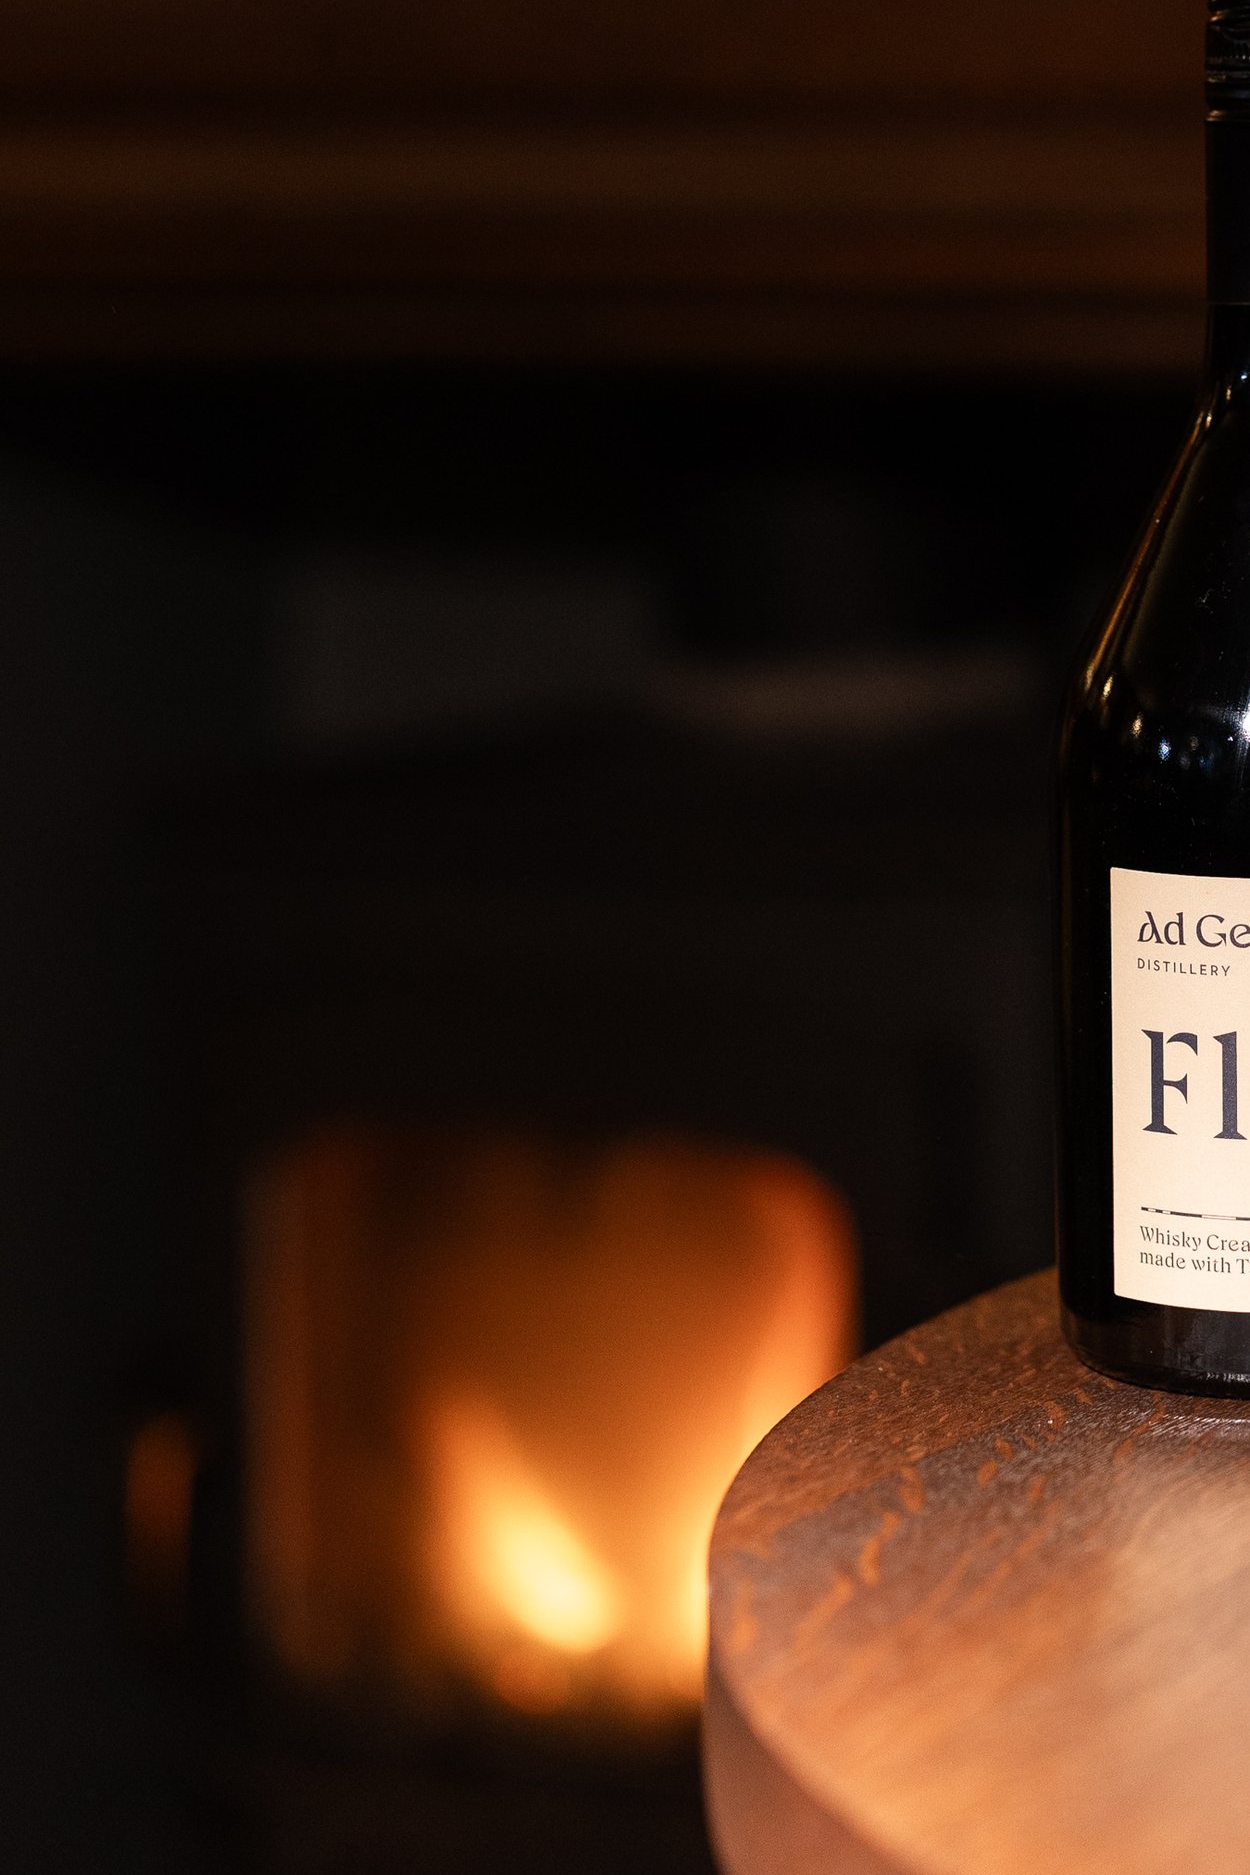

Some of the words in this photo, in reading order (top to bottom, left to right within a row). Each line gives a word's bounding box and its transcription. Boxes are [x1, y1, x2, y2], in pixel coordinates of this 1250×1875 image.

[1137, 911, 1186, 946] Ad
[1137, 957, 1231, 977] DISTILLERY
[1139, 1225, 1202, 1252] Whisky
[1139, 1251, 1186, 1270] made
[1191, 1256, 1231, 1274] with
